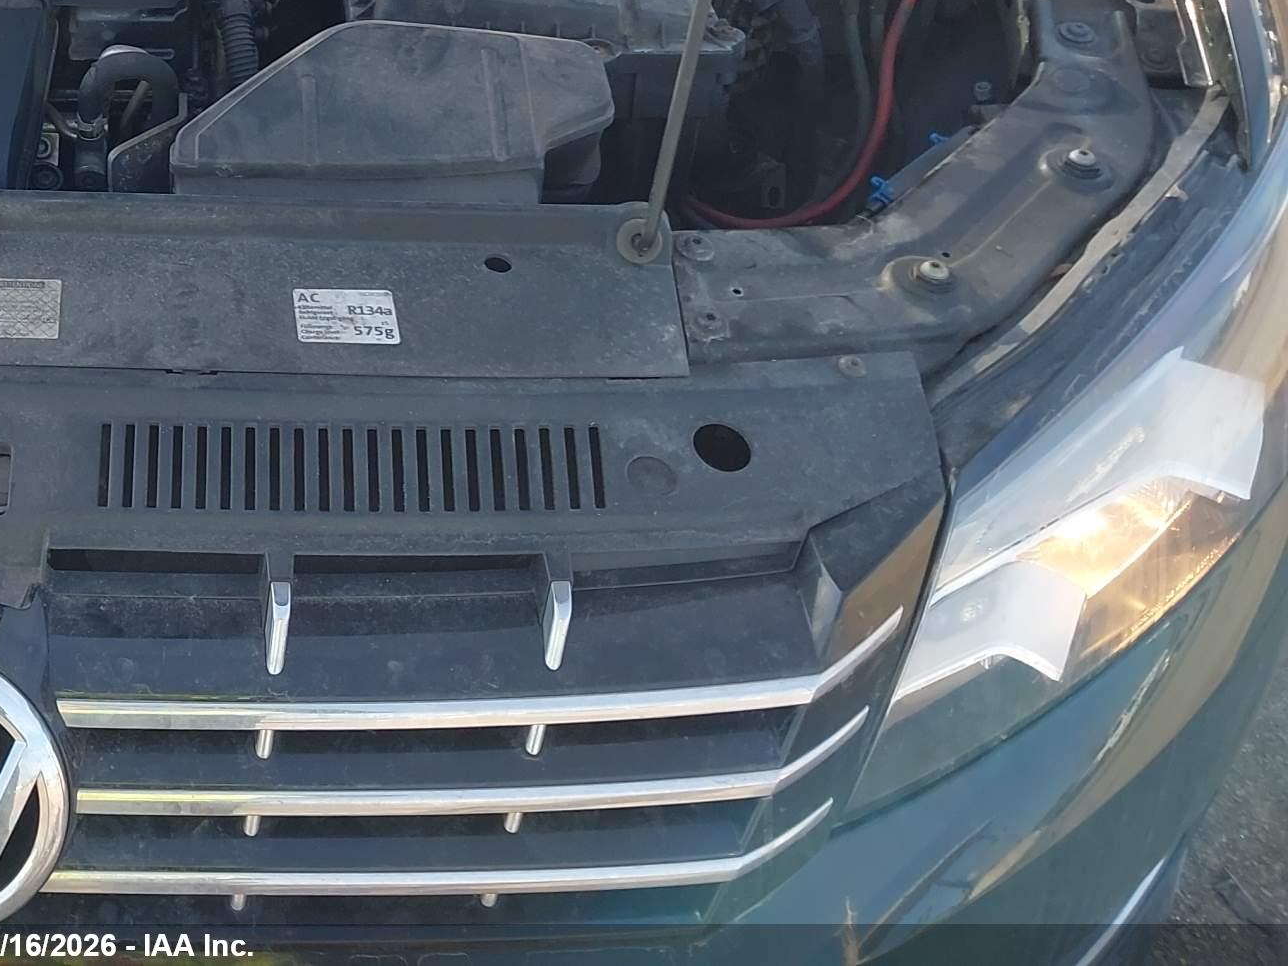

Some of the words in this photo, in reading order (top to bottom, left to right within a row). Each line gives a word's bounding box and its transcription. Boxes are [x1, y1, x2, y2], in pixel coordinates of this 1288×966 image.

[297, 293, 320, 303] AC
[347, 305, 393, 316] R134a
[354, 326, 395, 340] 575g
